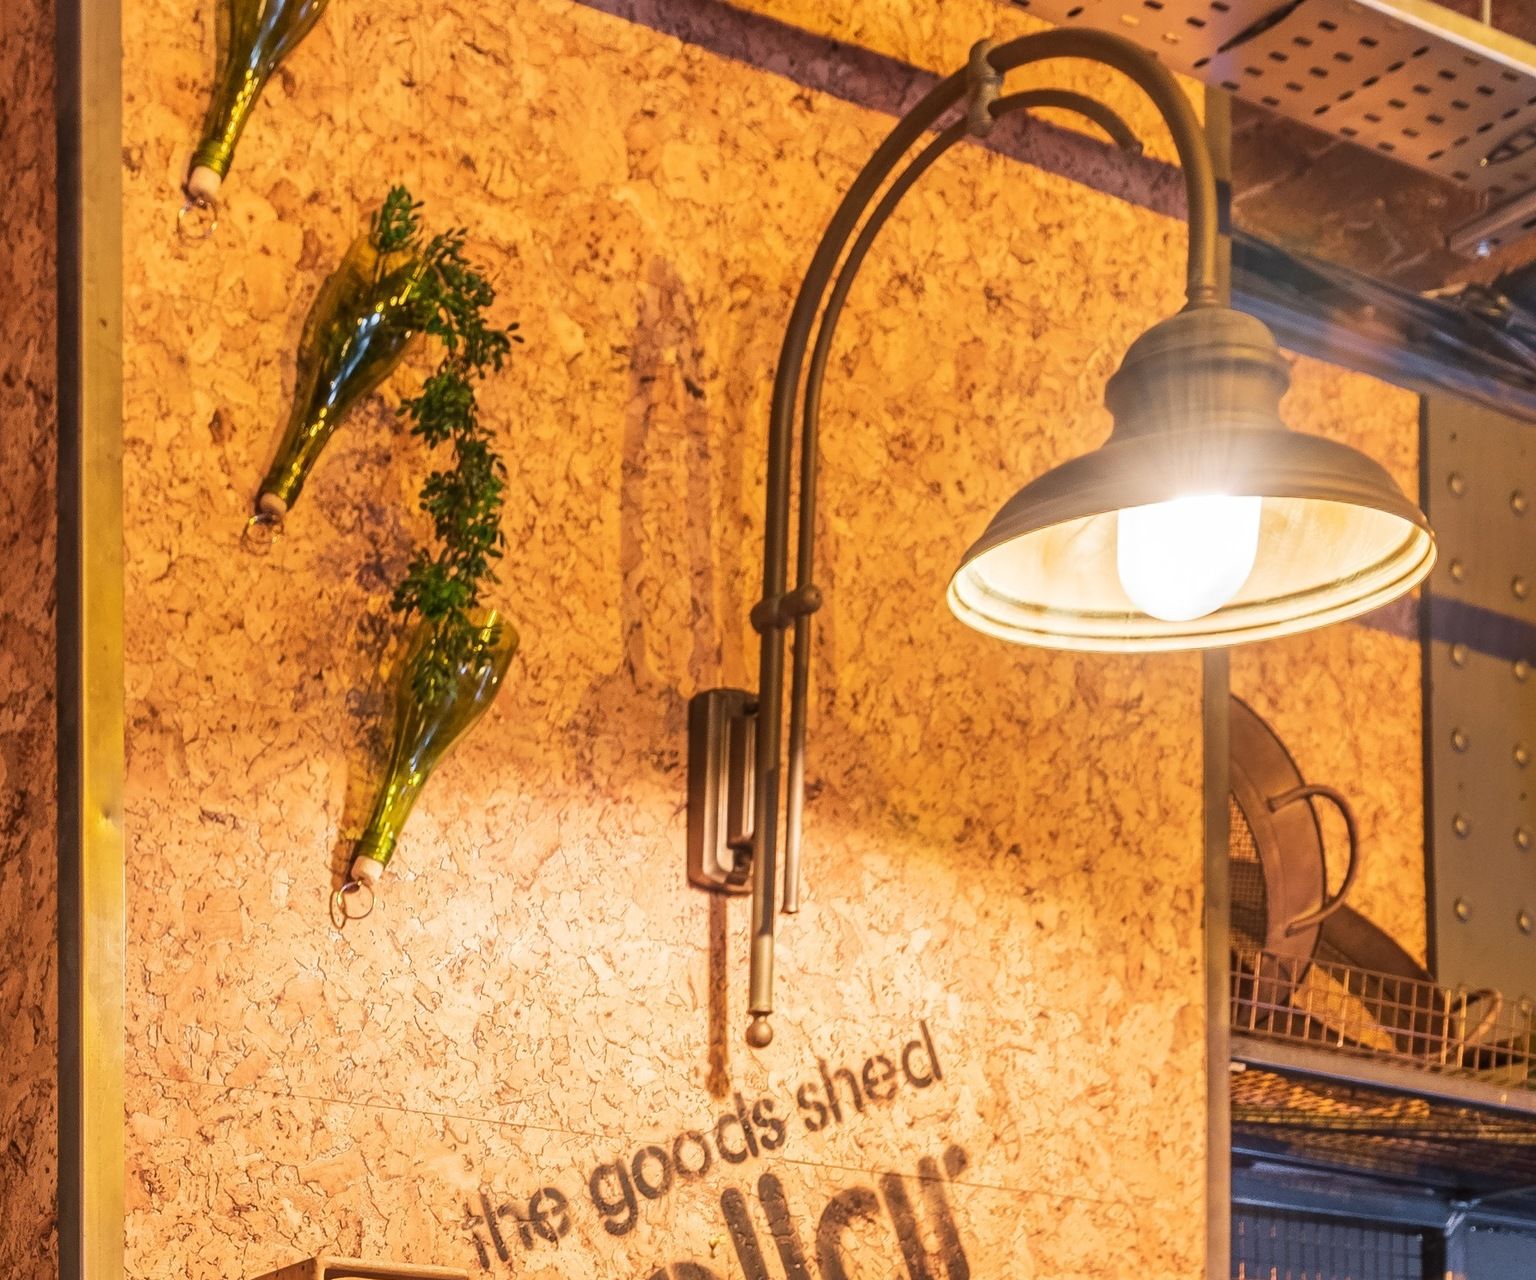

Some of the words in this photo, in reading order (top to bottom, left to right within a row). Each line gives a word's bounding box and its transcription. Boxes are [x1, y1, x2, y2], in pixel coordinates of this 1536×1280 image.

[462, 1187, 571, 1272] the
[589, 1093, 786, 1236] goods
[797, 1021, 943, 1132] shed
